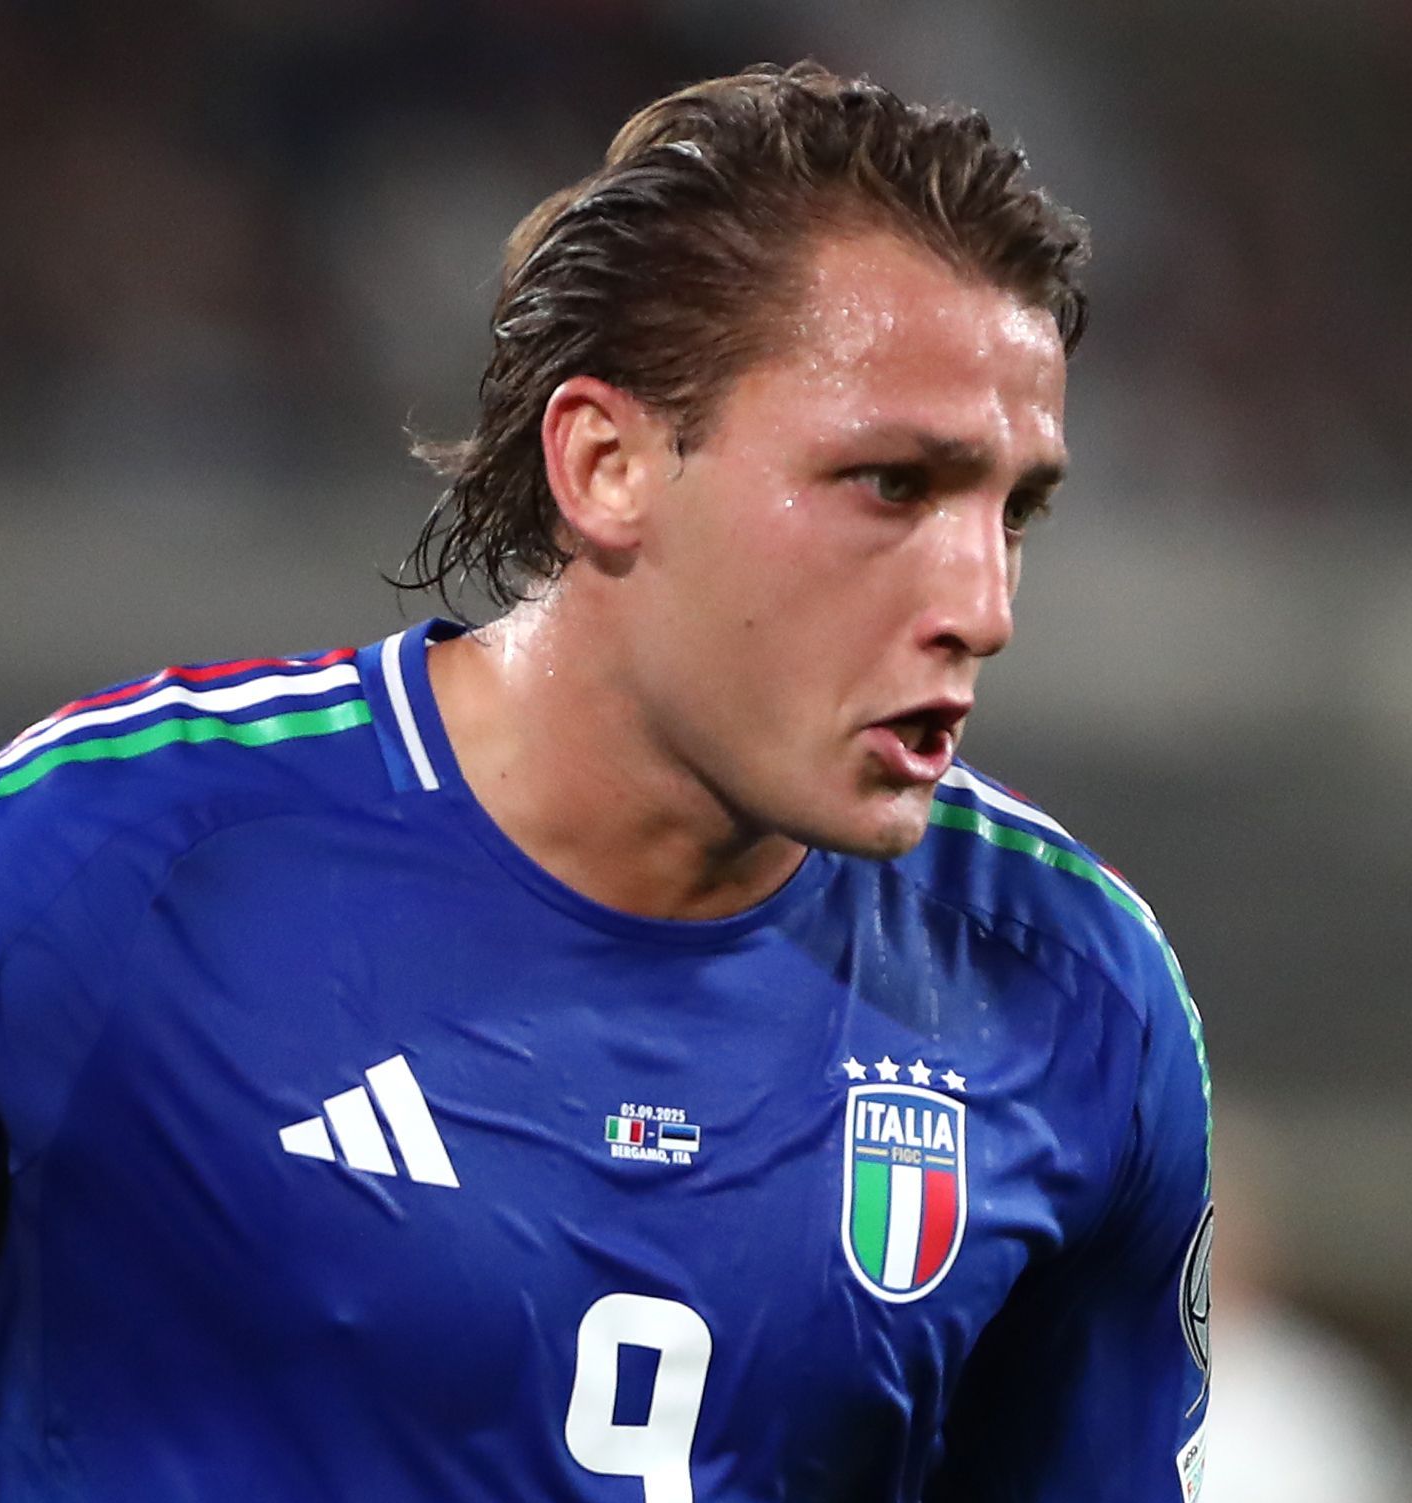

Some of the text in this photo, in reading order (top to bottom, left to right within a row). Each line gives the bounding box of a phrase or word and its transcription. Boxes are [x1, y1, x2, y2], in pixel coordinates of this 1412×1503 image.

[620, 1102, 686, 1123] 05.09.2025
[855, 1100, 955, 1152] ITALIA
[611, 1143, 692, 1165] BERGAMO, ITA
[891, 1146, 922, 1164] FIGC
